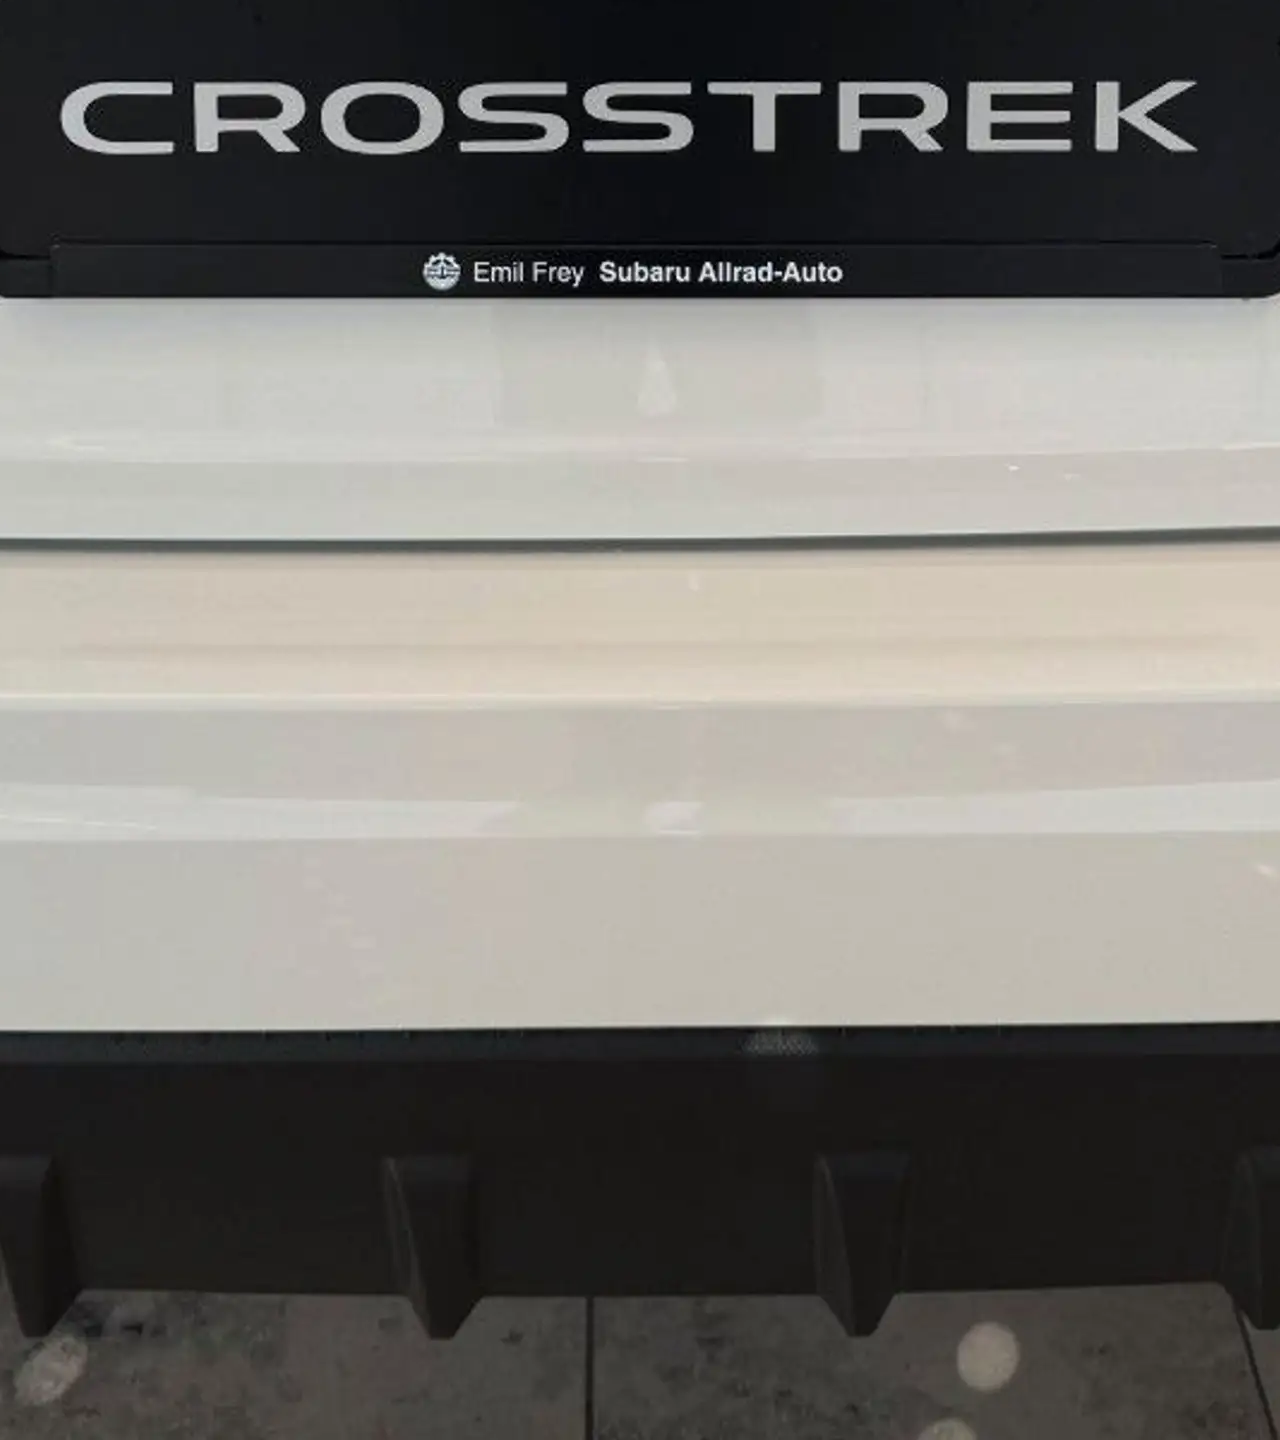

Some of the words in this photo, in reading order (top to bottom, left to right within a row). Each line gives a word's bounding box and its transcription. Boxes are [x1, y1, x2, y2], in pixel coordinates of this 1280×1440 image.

[60, 81, 1198, 154] CROSSTREK
[474, 262, 524, 283] Emil
[532, 262, 585, 288] Frey
[599, 262, 690, 283] Subaru
[698, 262, 844, 283] Allrad-Auto
